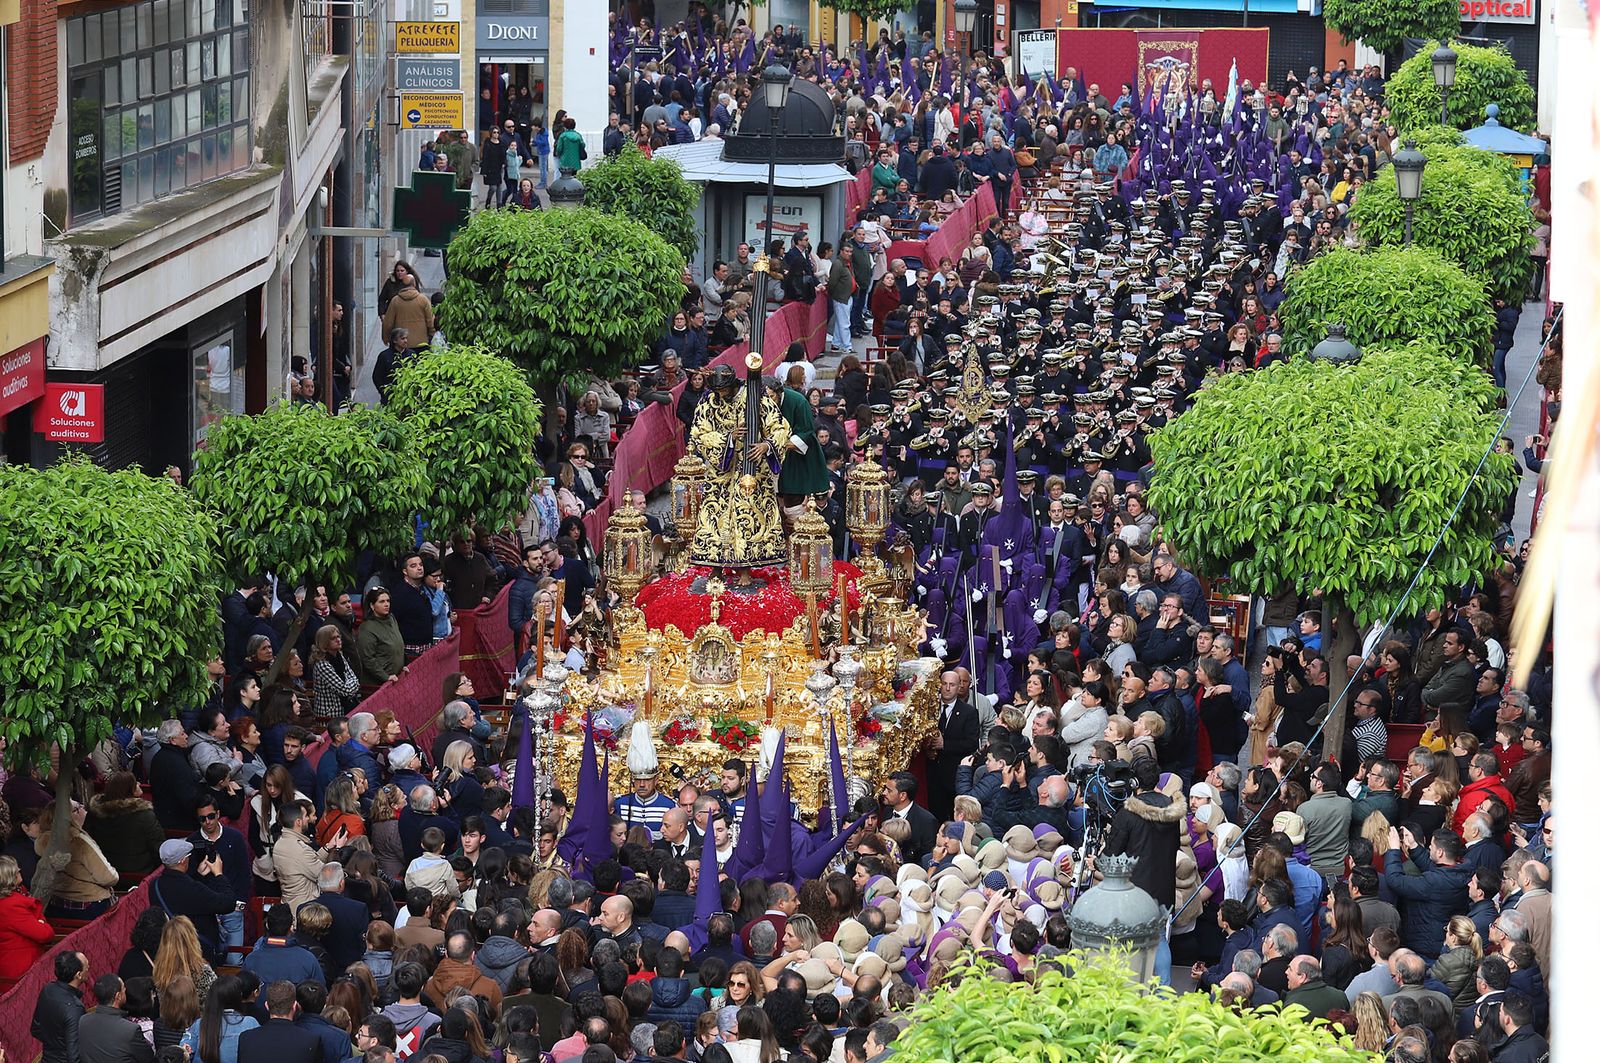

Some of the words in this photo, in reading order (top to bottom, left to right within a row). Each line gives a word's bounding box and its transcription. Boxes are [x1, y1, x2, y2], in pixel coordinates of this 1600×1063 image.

[1458, 0, 1531, 19] optical
[398, 25, 456, 35] ATREVETE
[487, 24, 538, 40] DIONI
[400, 38, 455, 47] PELUQUERIA
[405, 66, 454, 76] ANÁLISIS
[405, 77, 454, 87] CLÍNICOS
[79, 134, 94, 145] ACCESO
[75, 145, 97, 159] BOMBEROS
[2, 352, 31, 375] Soluciones
[2, 376, 28, 398] auditivas
[50, 417, 95, 427] Soluciones
[50, 429, 90, 438] auditivas
